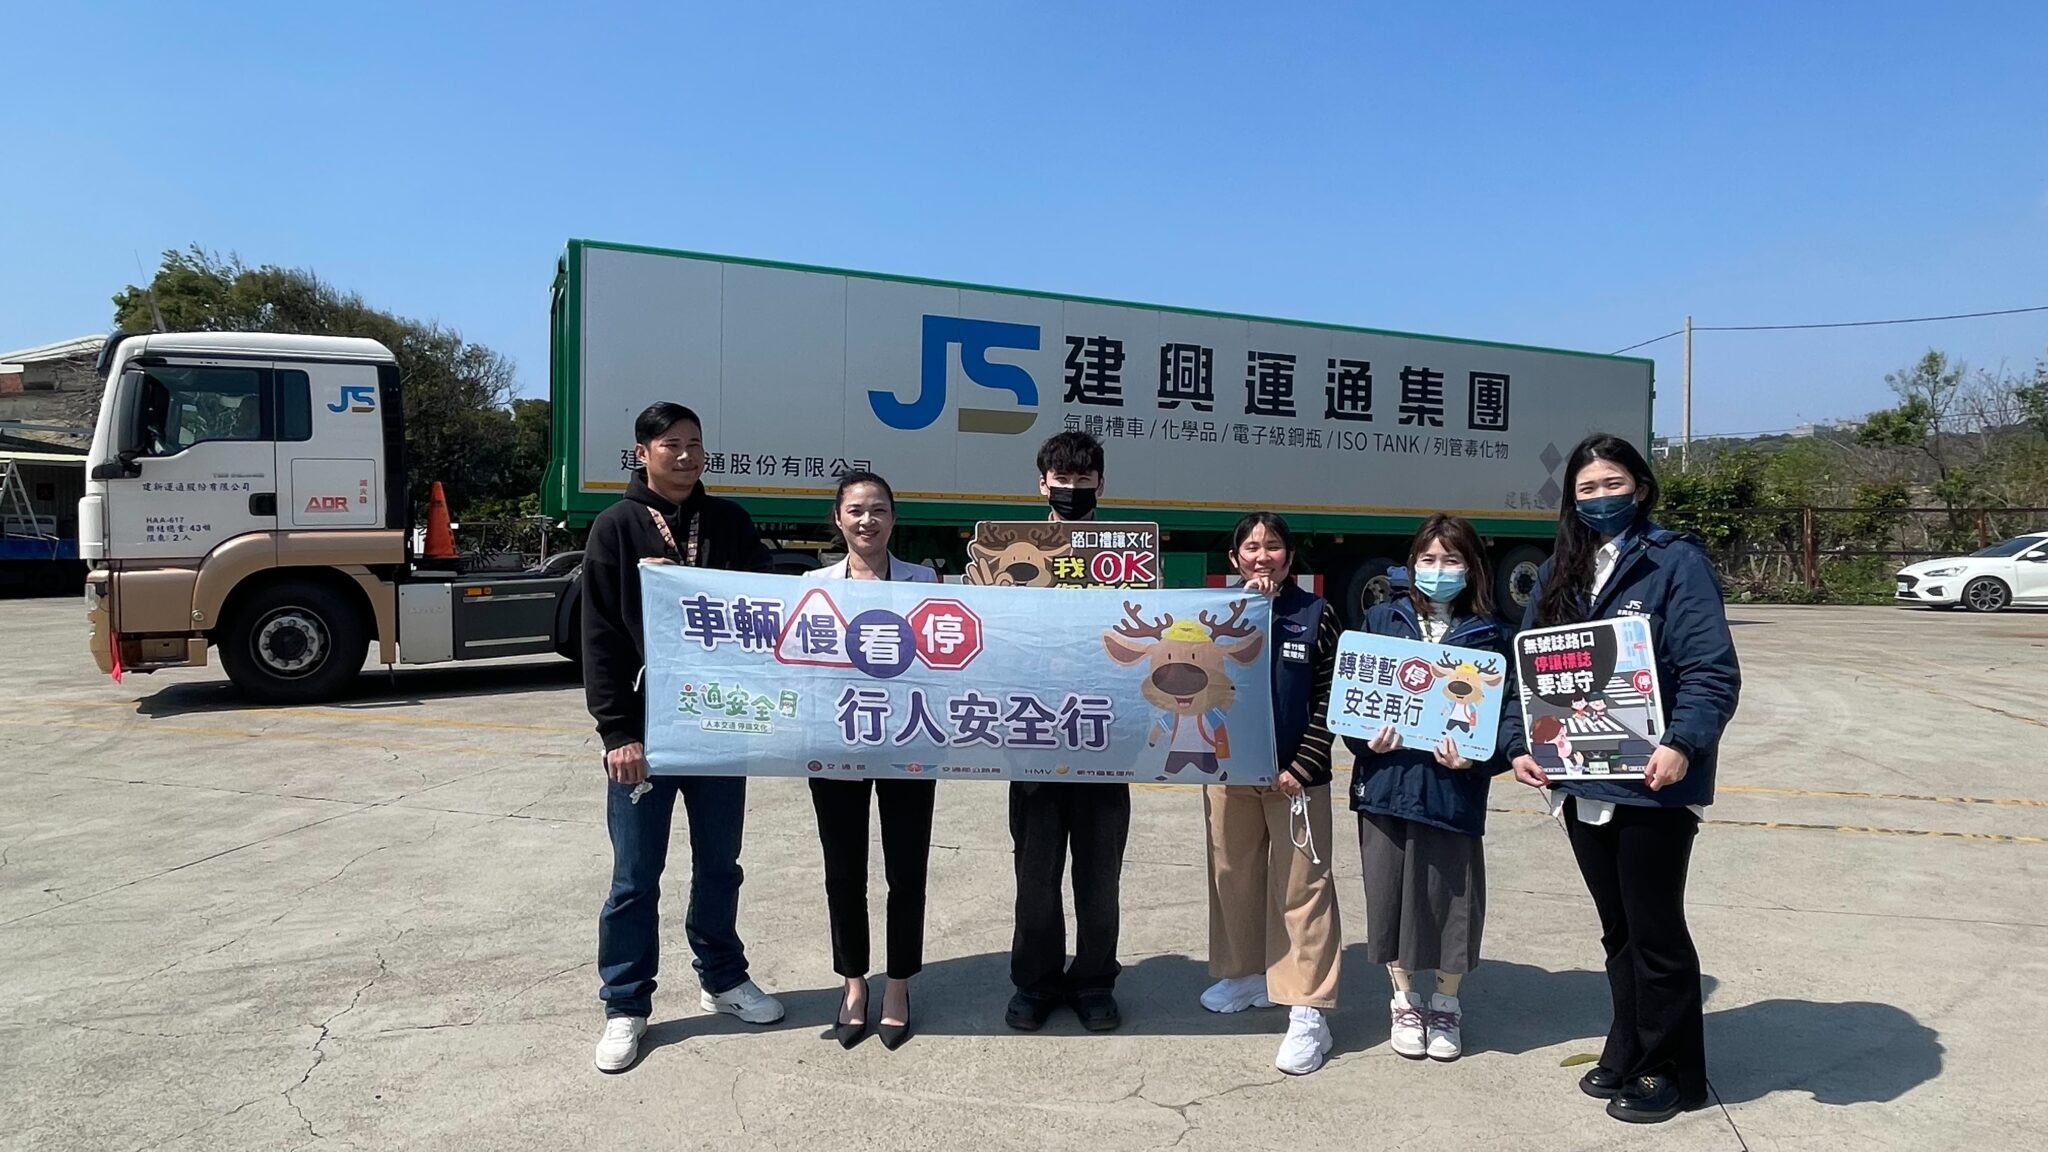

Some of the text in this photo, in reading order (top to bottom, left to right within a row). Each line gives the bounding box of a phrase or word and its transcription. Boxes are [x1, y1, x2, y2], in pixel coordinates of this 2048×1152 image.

[867, 315, 1041, 434] JS
[1063, 335, 1511, 431] 建興運通集團
[327, 385, 375, 413] JS
[1161, 418, 1217, 443] 化學品
[1337, 431, 1368, 451] ISO
[1373, 433, 1421, 455] TANK
[620, 449, 872, 478] 建通股份有限公司
[304, 496, 350, 513] ADR
[146, 516, 185, 524] HAA-617
[1071, 531, 1153, 548] 路口禮讓文化
[1053, 551, 1156, 584] 我 OK
[1523, 630, 1596, 655] 無號誌路口
[1534, 650, 1593, 673] 停讓標誌
[1535, 669, 1595, 697] 要遵守
[837, 687, 1112, 748] 行人安全行
[1342, 687, 1424, 727] 安全再行
